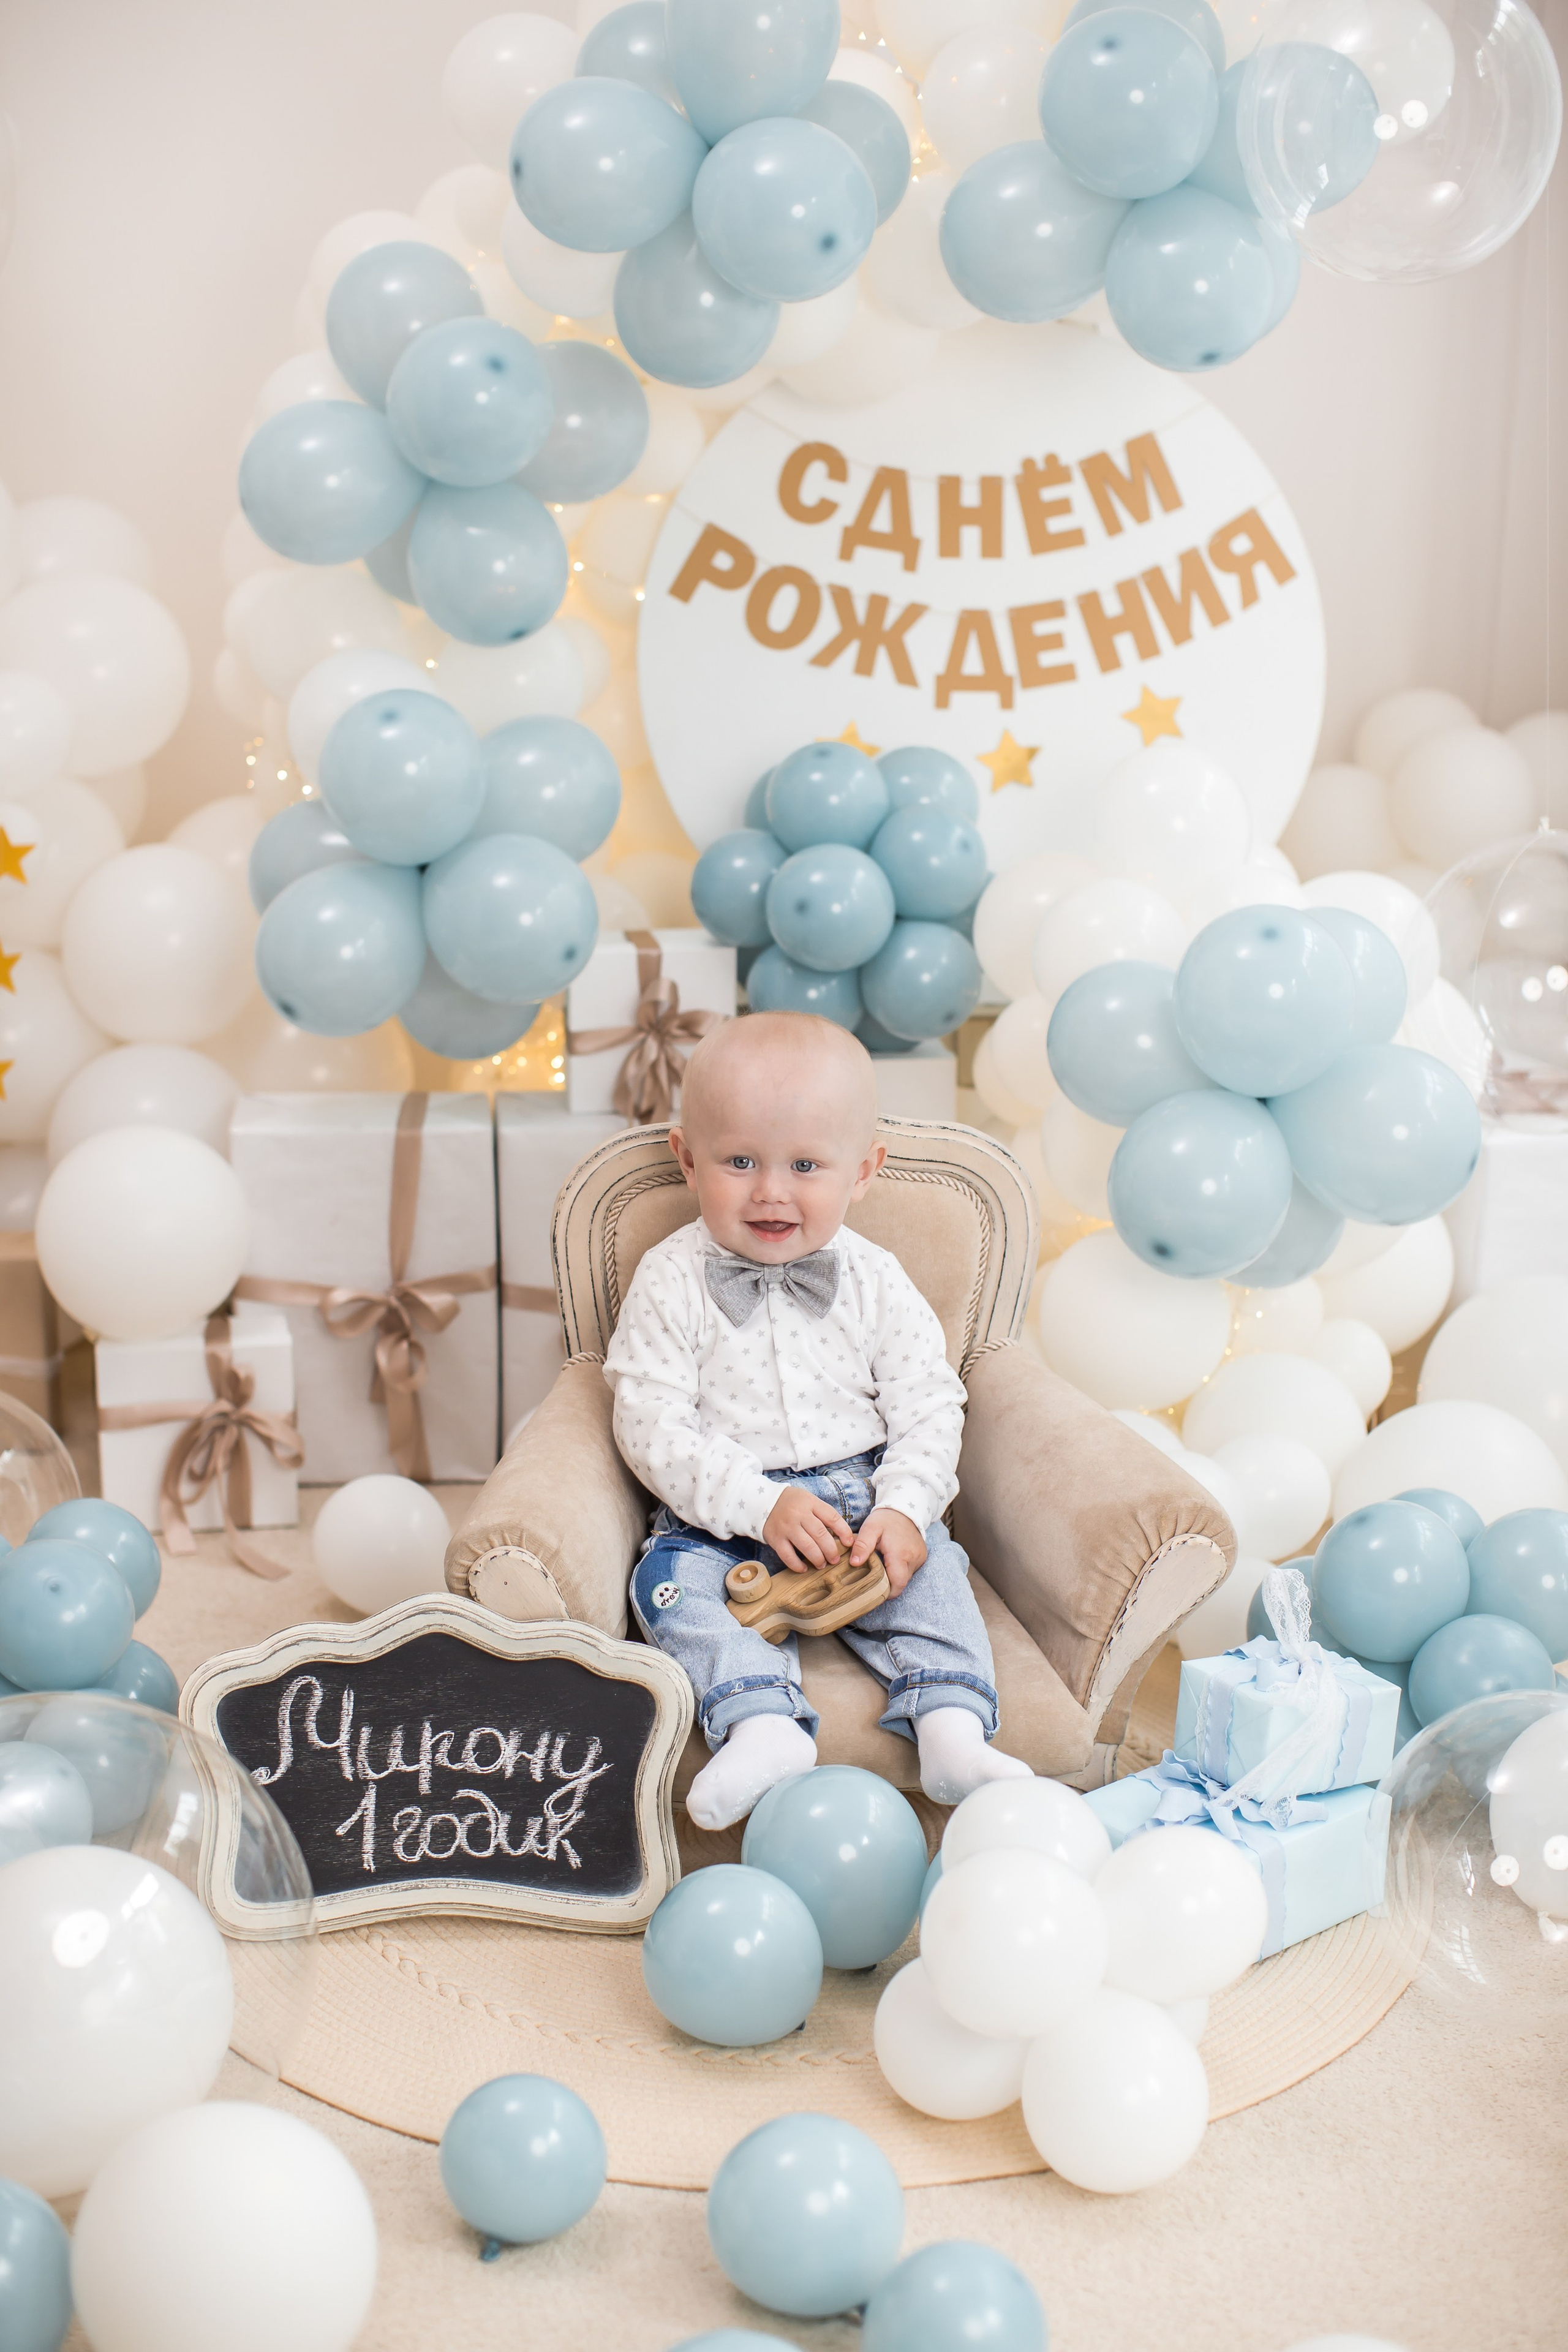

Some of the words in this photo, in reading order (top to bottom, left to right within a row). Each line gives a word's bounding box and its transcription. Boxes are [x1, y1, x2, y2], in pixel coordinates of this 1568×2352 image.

[668, 507, 1297, 710] РОЖДЕНИЯ
[334, 1782, 377, 1872] 1
[393, 1789, 586, 1869] годик
